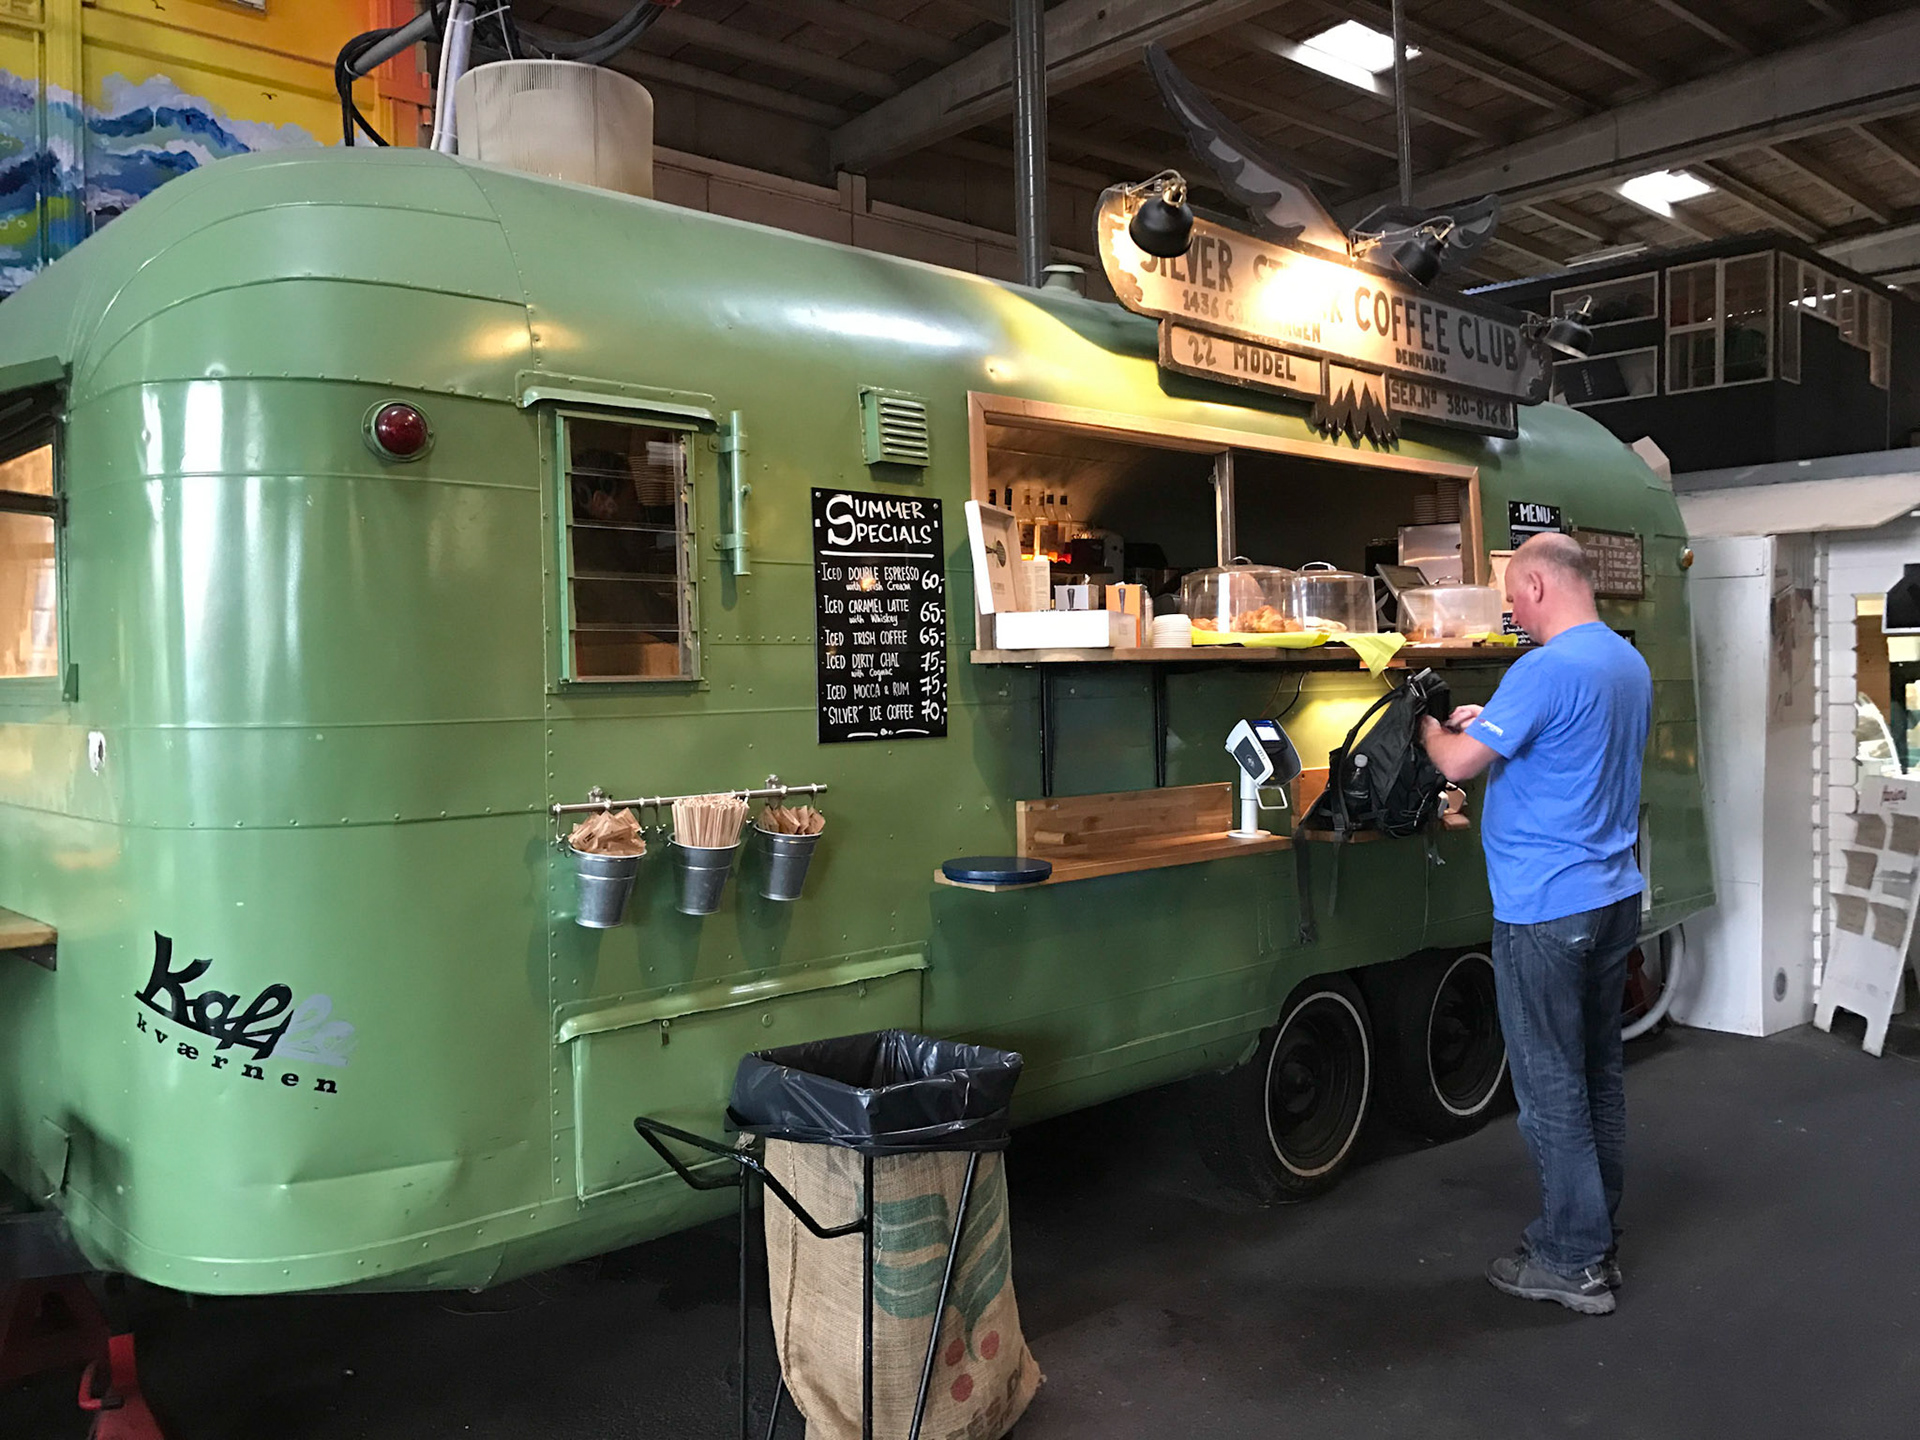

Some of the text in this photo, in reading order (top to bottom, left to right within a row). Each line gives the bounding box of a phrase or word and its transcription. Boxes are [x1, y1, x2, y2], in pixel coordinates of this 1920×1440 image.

[1182, 289, 1219, 319] 1436
[1396, 347, 1447, 374] DENMARK
[1354, 286, 1450, 355] COFFEE
[1458, 315, 1519, 371] CLUB
[1233, 342, 1297, 381] MODEL
[1519, 503, 1551, 524] MENU
[884, 566, 920, 581] ESPRESSO
[848, 599, 884, 614] CARAMEL
[887, 599, 910, 613] LATTE
[848, 613, 899, 627] with Whiskey
[853, 632, 877, 646] IRISH
[880, 630, 908, 645] COFFEE
[851, 653, 875, 669] DIRTY
[880, 652, 900, 668] CHAI
[853, 683, 881, 700] MOCCA
[892, 682, 910, 697] RUM
[868, 705, 883, 722] ICE
[886, 704, 914, 721] COFFEE
[136, 1012, 338, 1094] kværnen
